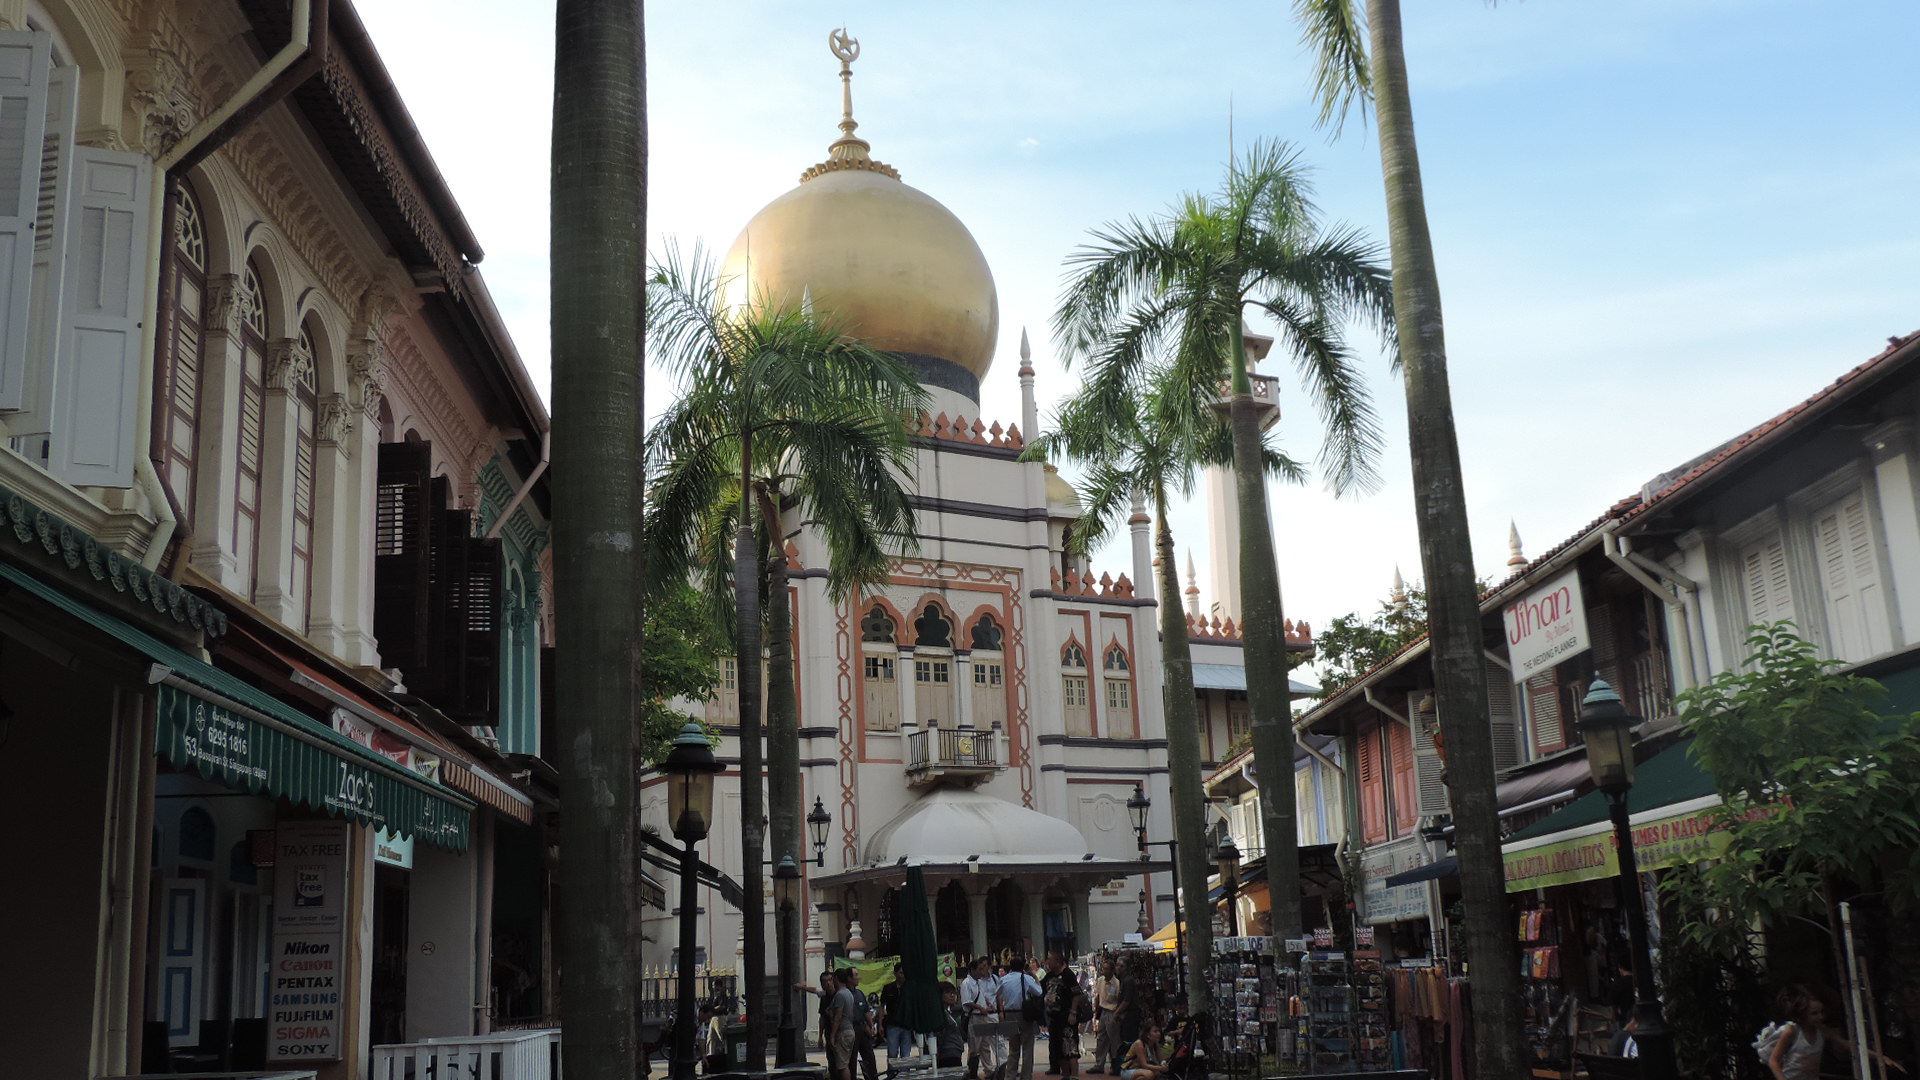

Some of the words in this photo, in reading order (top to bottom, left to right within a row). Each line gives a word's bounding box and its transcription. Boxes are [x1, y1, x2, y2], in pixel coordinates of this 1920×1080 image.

[1506, 586, 1571, 645] Jihan
[1523, 660, 1533, 671] THE
[1533, 648, 1554, 666] WEDDING
[1554, 636, 1577, 654] PLANNER
[208, 726, 227, 747] 6295
[229, 735, 247, 755] 1816
[185, 735, 197, 756] 53
[229, 758, 252, 775] Singapore
[339, 761, 374, 809] Zac's
[1662, 823, 1669, 841] &
[282, 845, 308, 857] TAX
[311, 844, 342, 856] FREE
[1551, 842, 1605, 872] AROMATICS
[300, 873, 319, 882] tax
[299, 881, 322, 893] free
[284, 941, 330, 955] Nikon
[280, 959, 333, 972] Canon
[278, 976, 334, 989] PENTAX
[273, 993, 337, 1006] SAMSUNG
[276, 1010, 333, 1023] FUJIFILM
[276, 1026, 331, 1041] SIGMA
[278, 1044, 330, 1056] SONY
